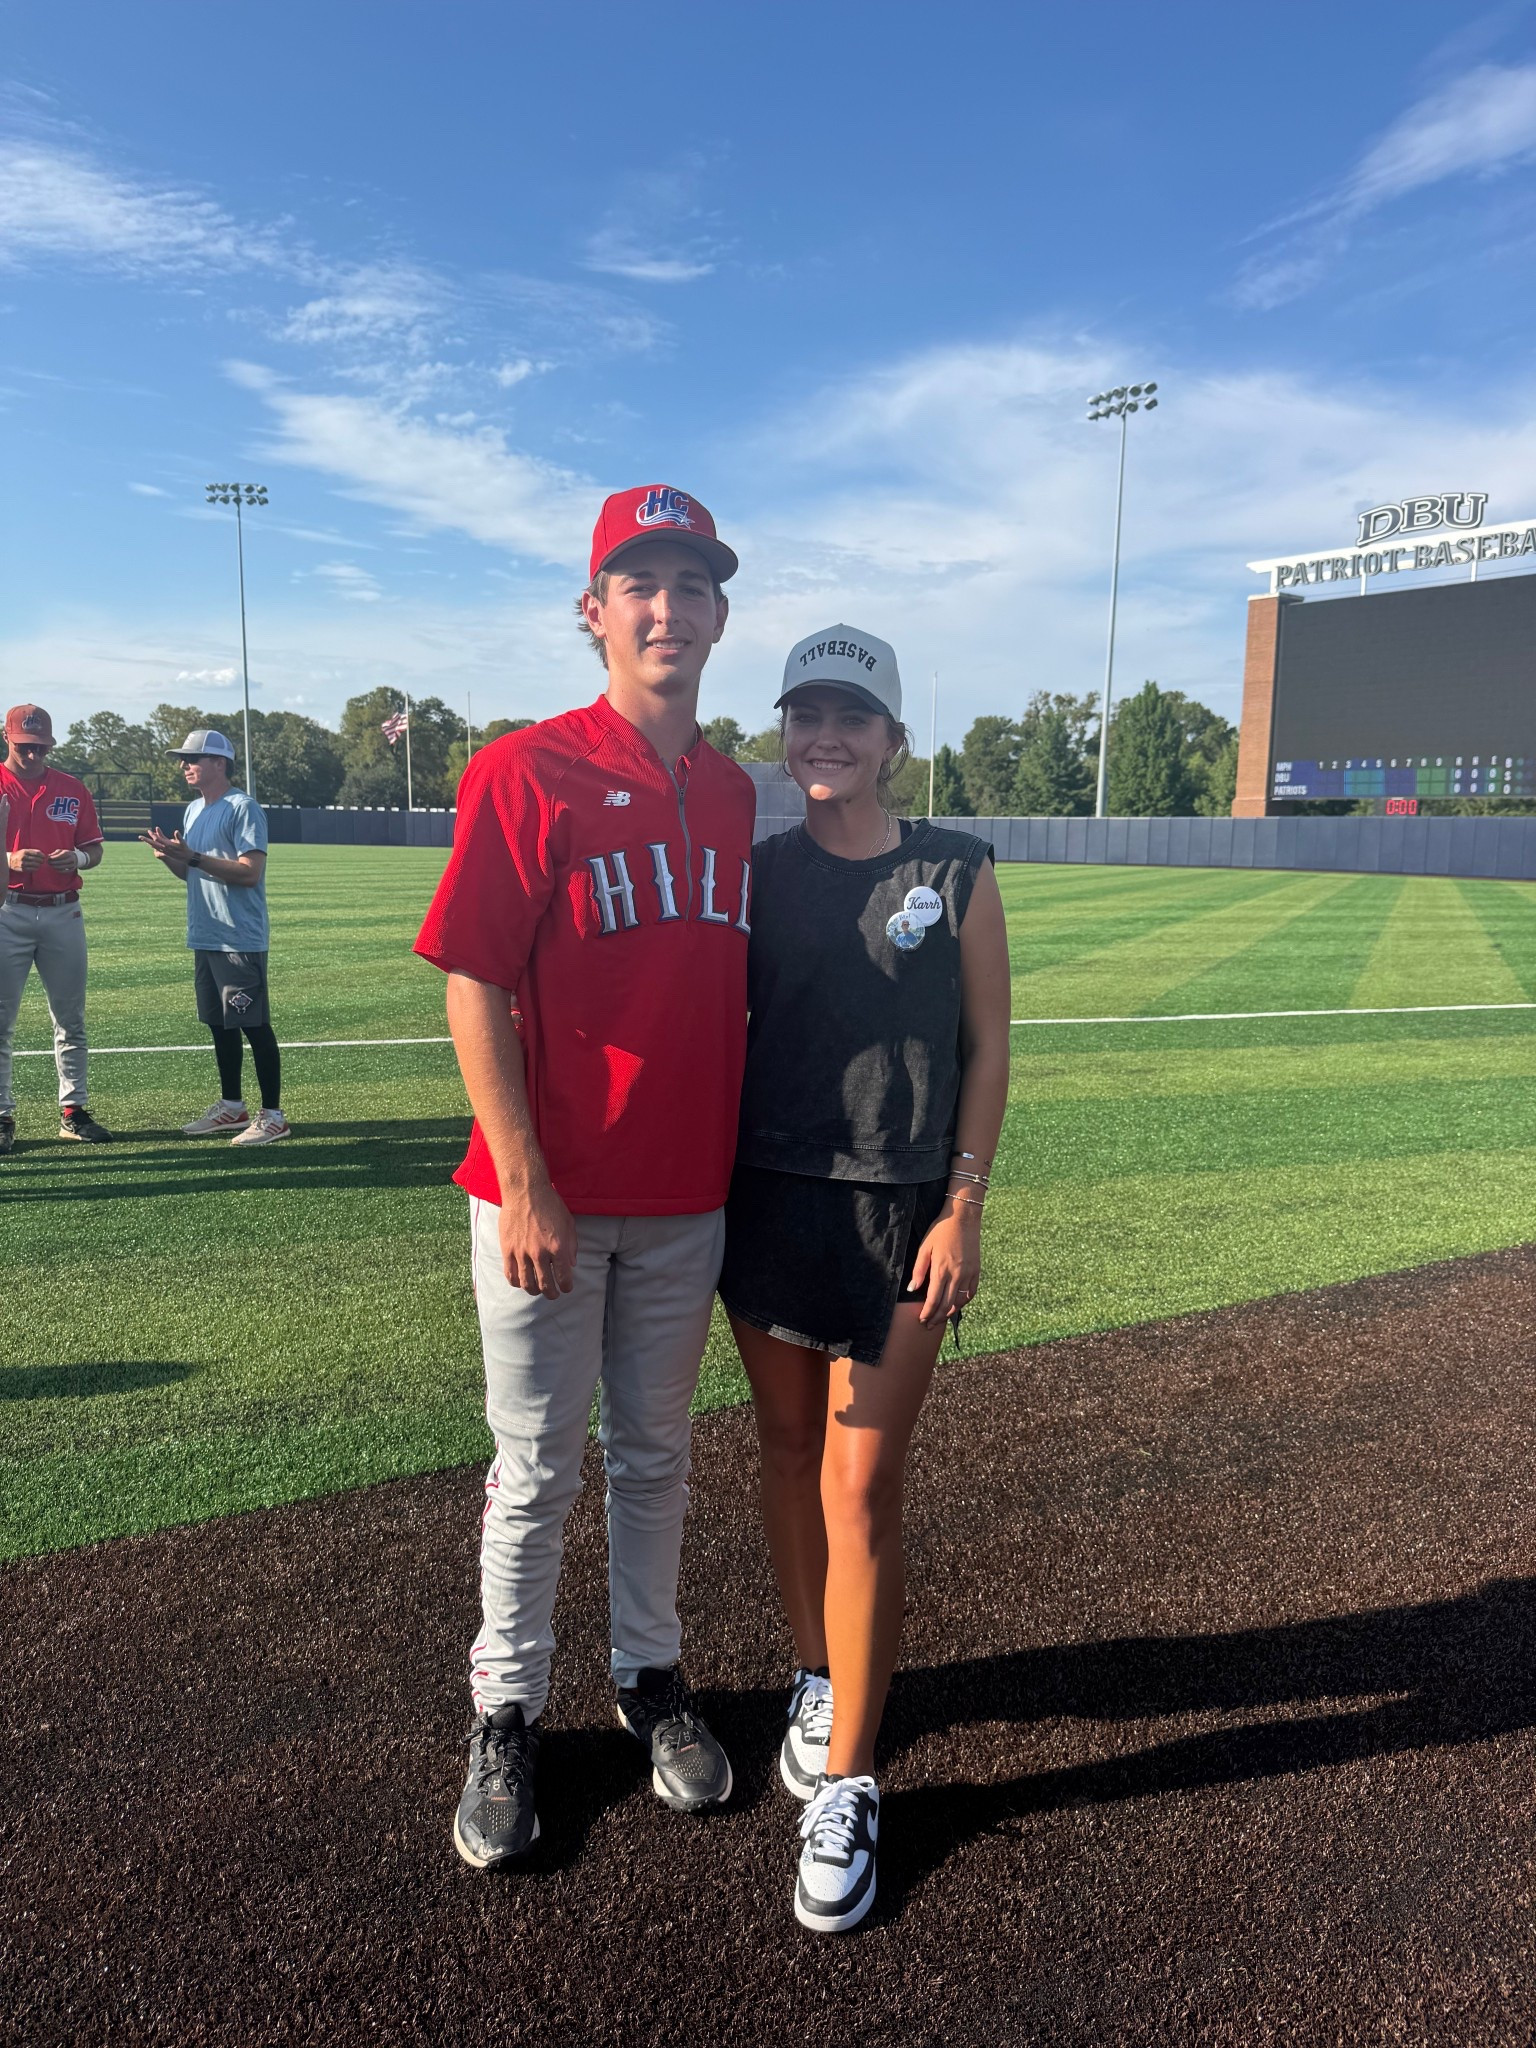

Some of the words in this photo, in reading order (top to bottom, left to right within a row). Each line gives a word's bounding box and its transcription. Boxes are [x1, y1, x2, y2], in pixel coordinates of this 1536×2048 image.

[644, 488, 690, 522] HC
[1356, 493, 1488, 547] DBU
[1276, 547, 1405, 588] PATRIOT
[1411, 527, 1536, 572] BASEBA
[800, 641, 877, 672] BASEBALL
[1319, 761, 1324, 769] 1
[1331, 761, 1338, 769] 2
[1345, 760, 1352, 769] 3
[1361, 760, 1367, 768] 4
[1376, 759, 1382, 768] 5
[1390, 758, 1397, 768] 6
[1405, 758, 1412, 767] 7
[1435, 757, 1442, 767] 9
[1274, 785, 1307, 796] PATRIOTS
[51, 796, 80, 817] HC
[1386, 799, 1417, 815] 0:00
[907, 896, 941, 910] Karrh
